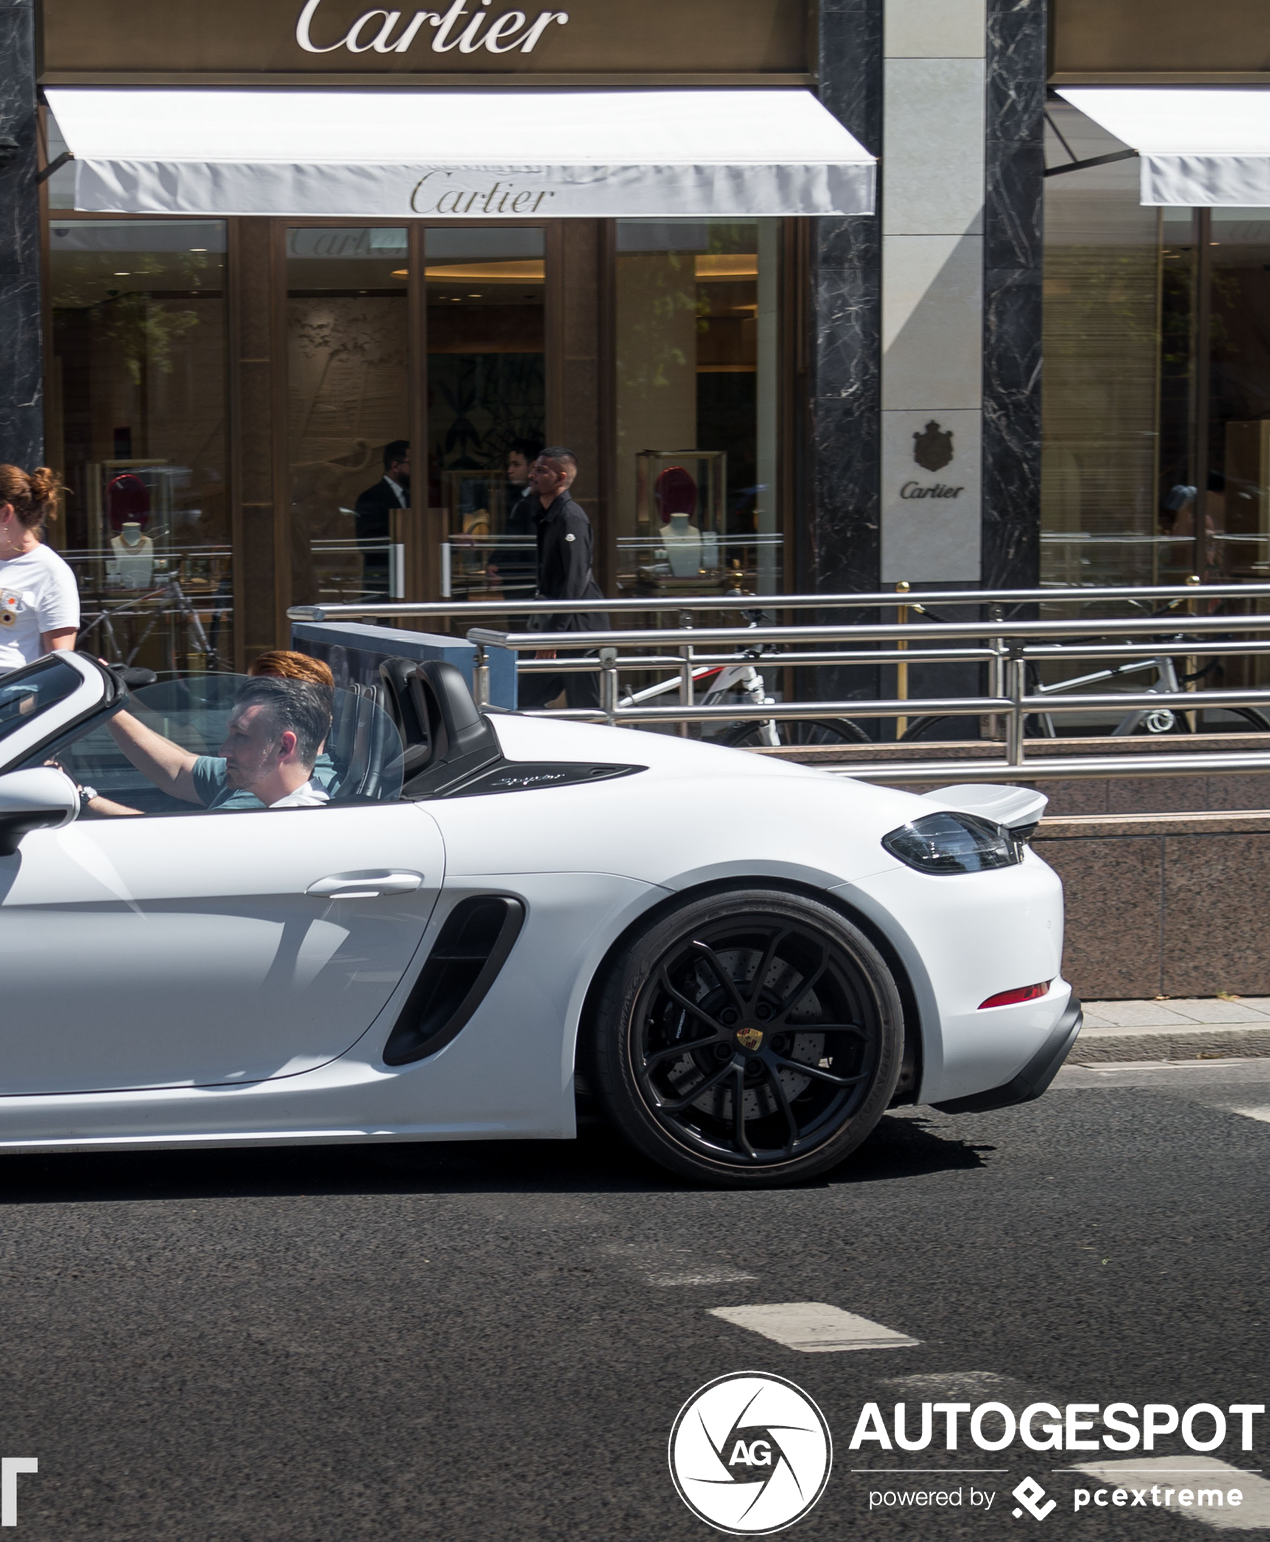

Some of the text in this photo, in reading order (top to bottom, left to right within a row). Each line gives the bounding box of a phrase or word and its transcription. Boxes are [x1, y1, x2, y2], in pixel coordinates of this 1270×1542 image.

[296, 0, 569, 53] Cartier
[410, 169, 556, 214] Cartier
[899, 481, 965, 500] Cartier
